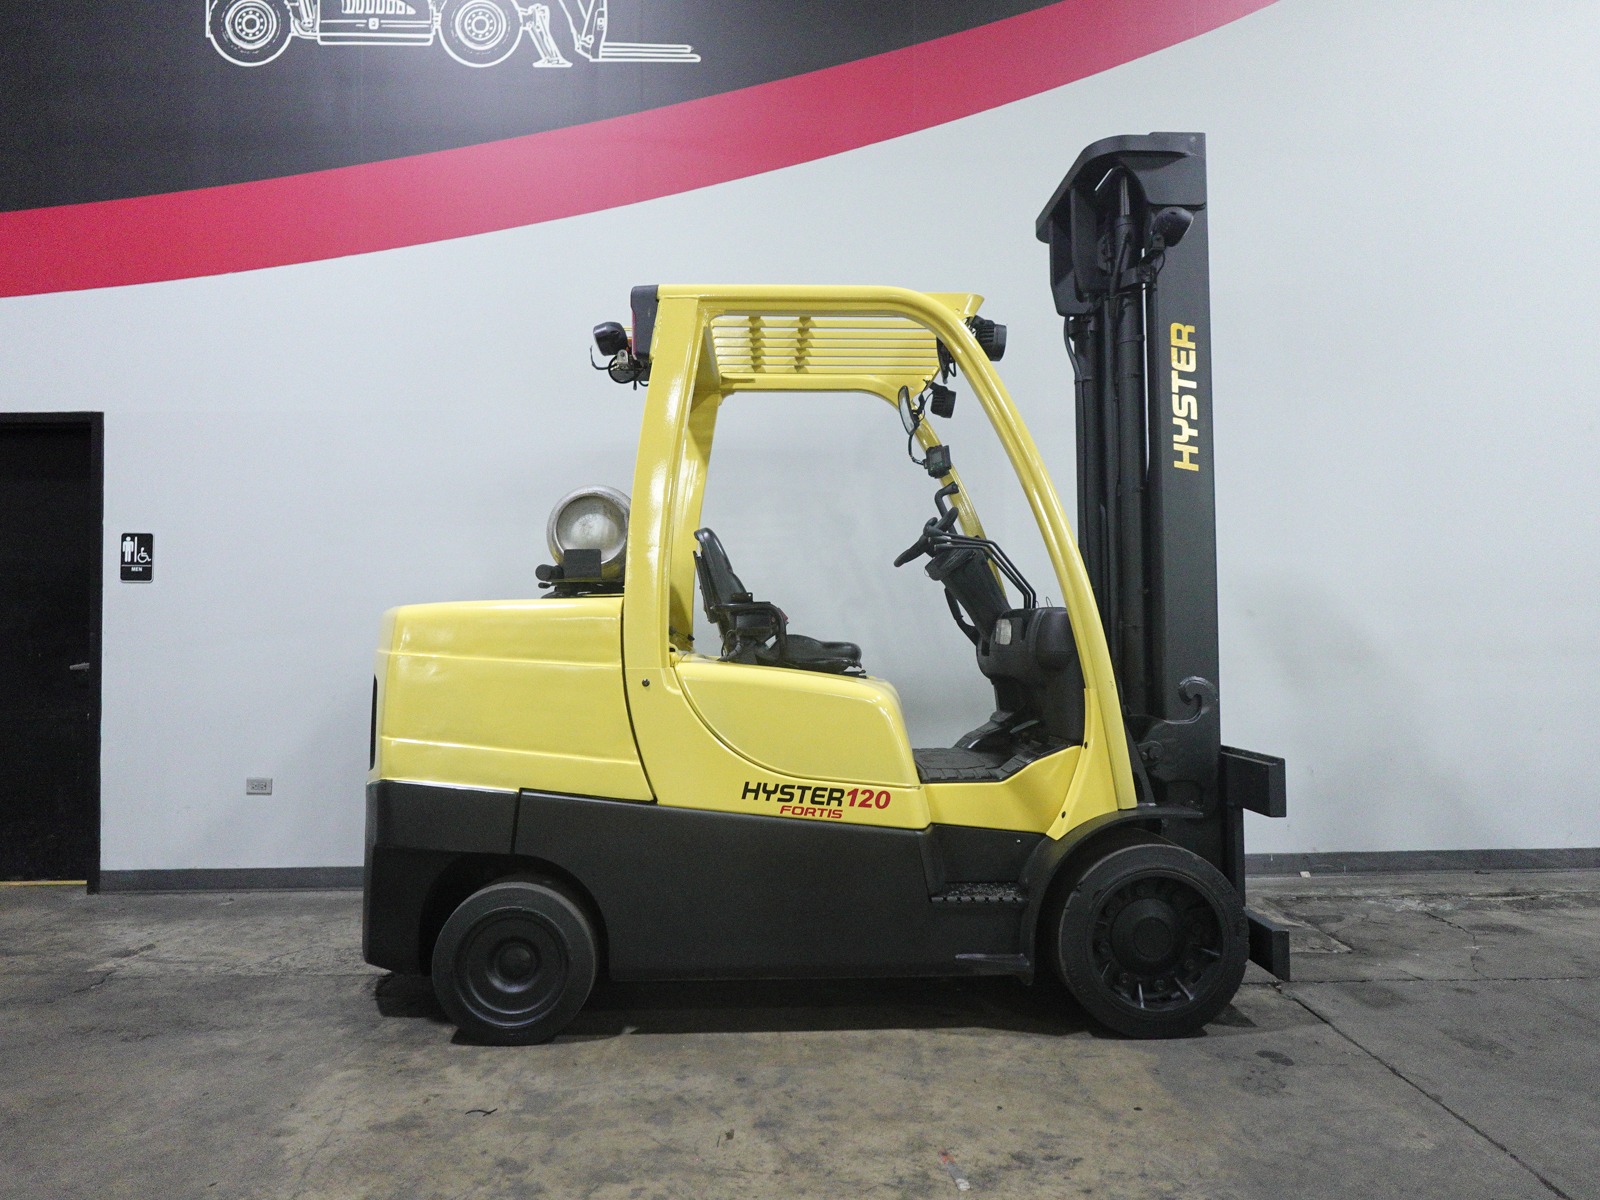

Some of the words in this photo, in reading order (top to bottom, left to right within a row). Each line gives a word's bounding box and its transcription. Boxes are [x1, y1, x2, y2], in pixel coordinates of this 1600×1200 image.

[1170, 322, 1200, 472] HYSTER
[741, 781, 845, 807] HYSTER
[847, 788, 891, 810] 120
[779, 805, 843, 819] FORTIS
